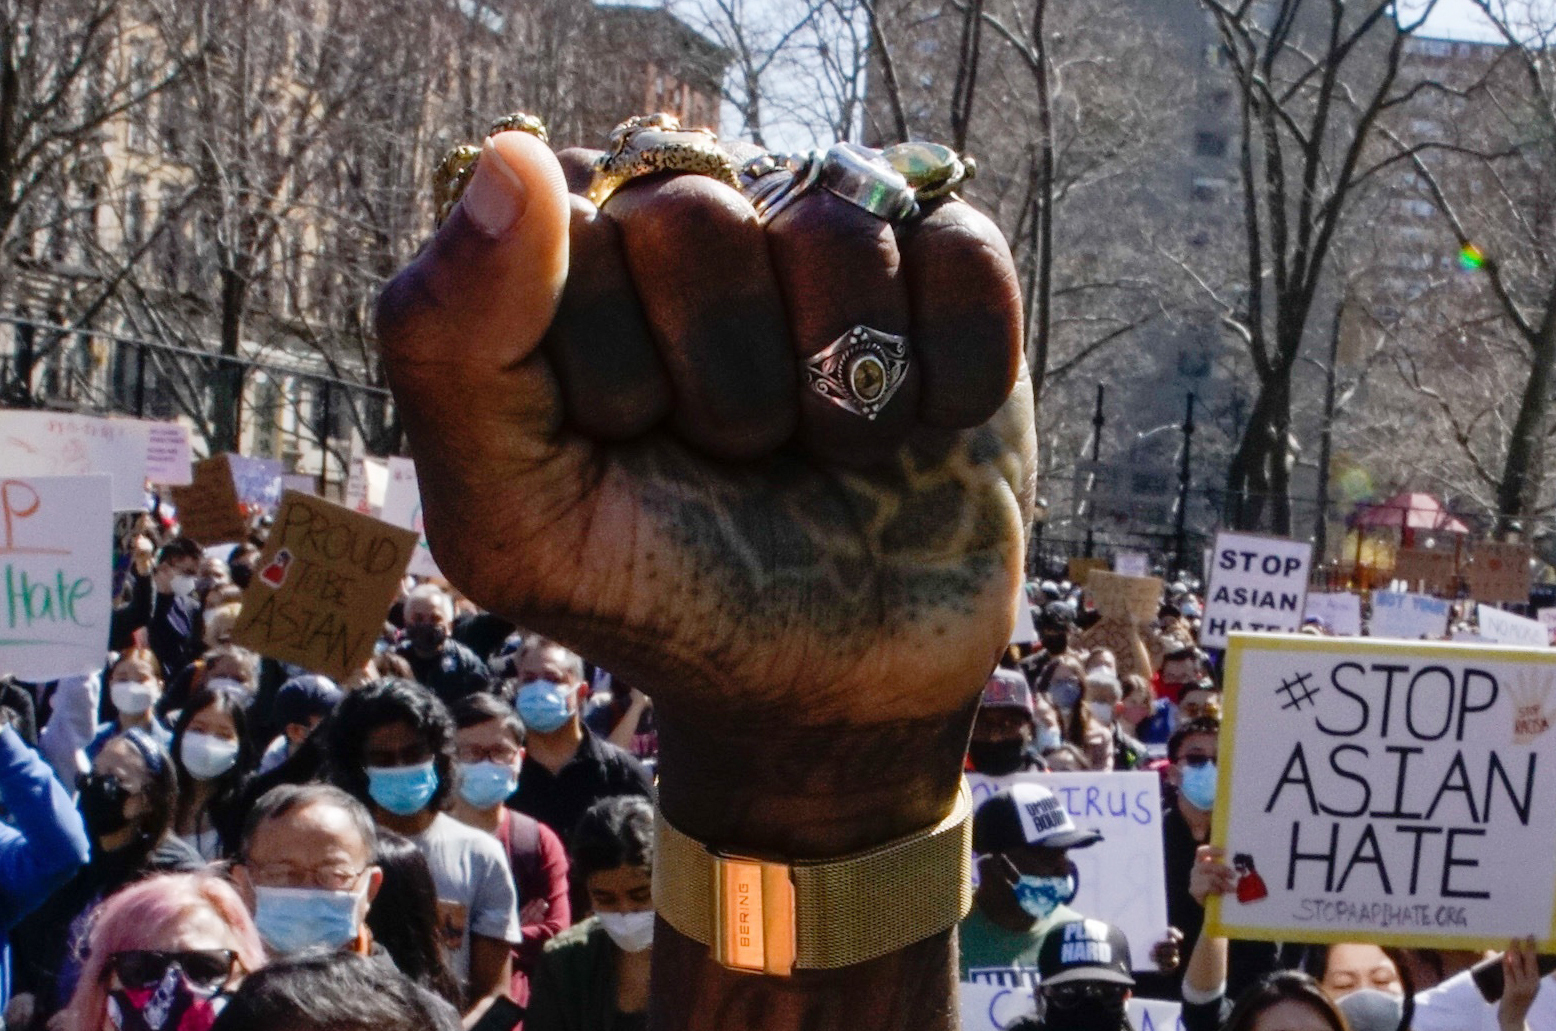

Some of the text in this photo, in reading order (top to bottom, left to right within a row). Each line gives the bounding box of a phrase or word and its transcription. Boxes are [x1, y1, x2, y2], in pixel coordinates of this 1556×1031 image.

[281, 502, 397, 575] PROUD
[1219, 549, 1301, 577] STOP
[5, 564, 95, 628] Hate
[1213, 586, 1298, 612] ASIAN
[243, 594, 366, 668] ASIAN
[1275, 662, 1499, 741] #STOP
[1059, 786, 1151, 824] IRUS
[1265, 742, 1537, 826] ASIAN
[1286, 821, 1491, 899] HATE
[739, 882, 749, 947] BERING
